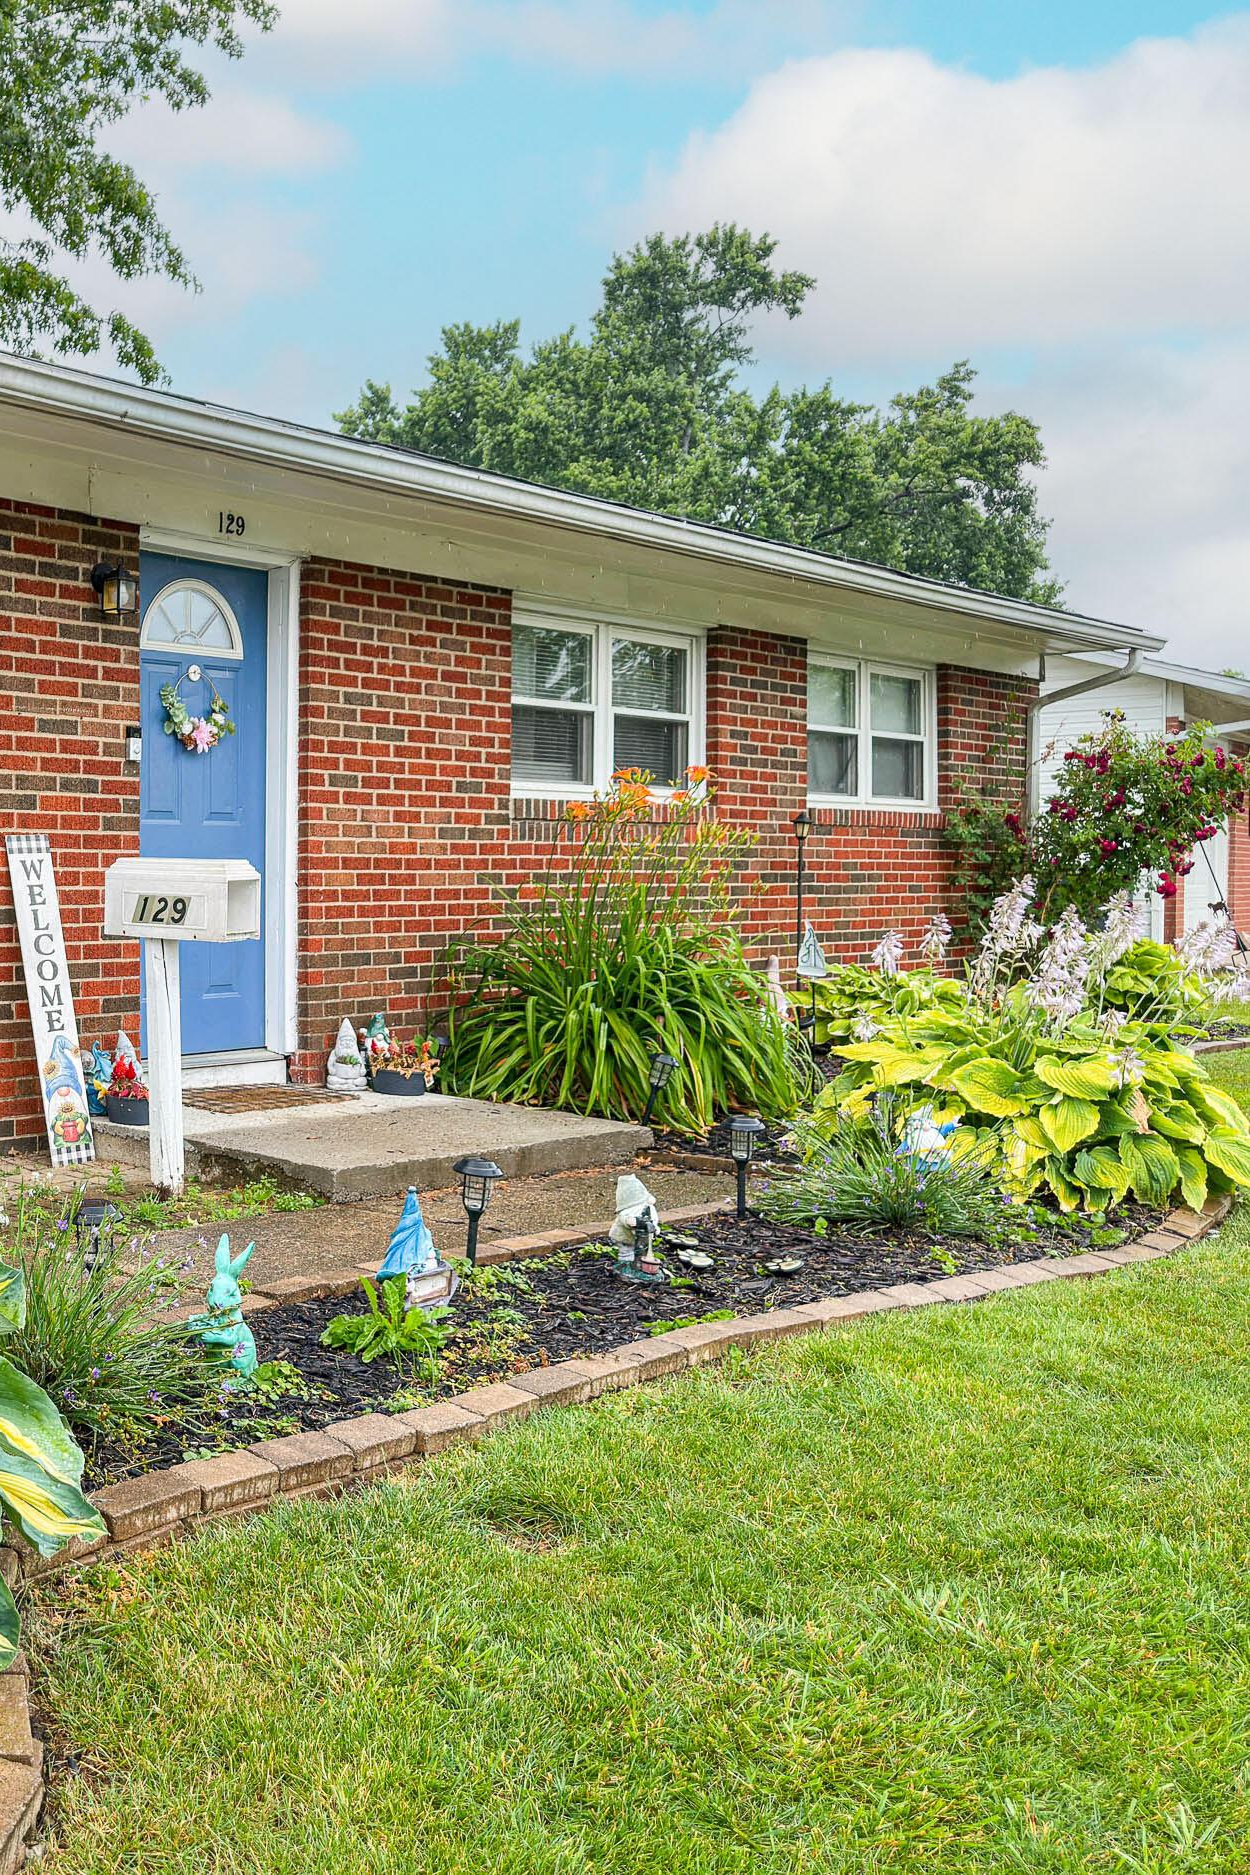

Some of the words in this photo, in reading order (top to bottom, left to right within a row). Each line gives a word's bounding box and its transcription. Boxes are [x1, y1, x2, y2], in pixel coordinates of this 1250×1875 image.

[218, 511, 245, 536] 129
[138, 896, 187, 924] 129
[19, 858, 65, 1033] WELCOME
